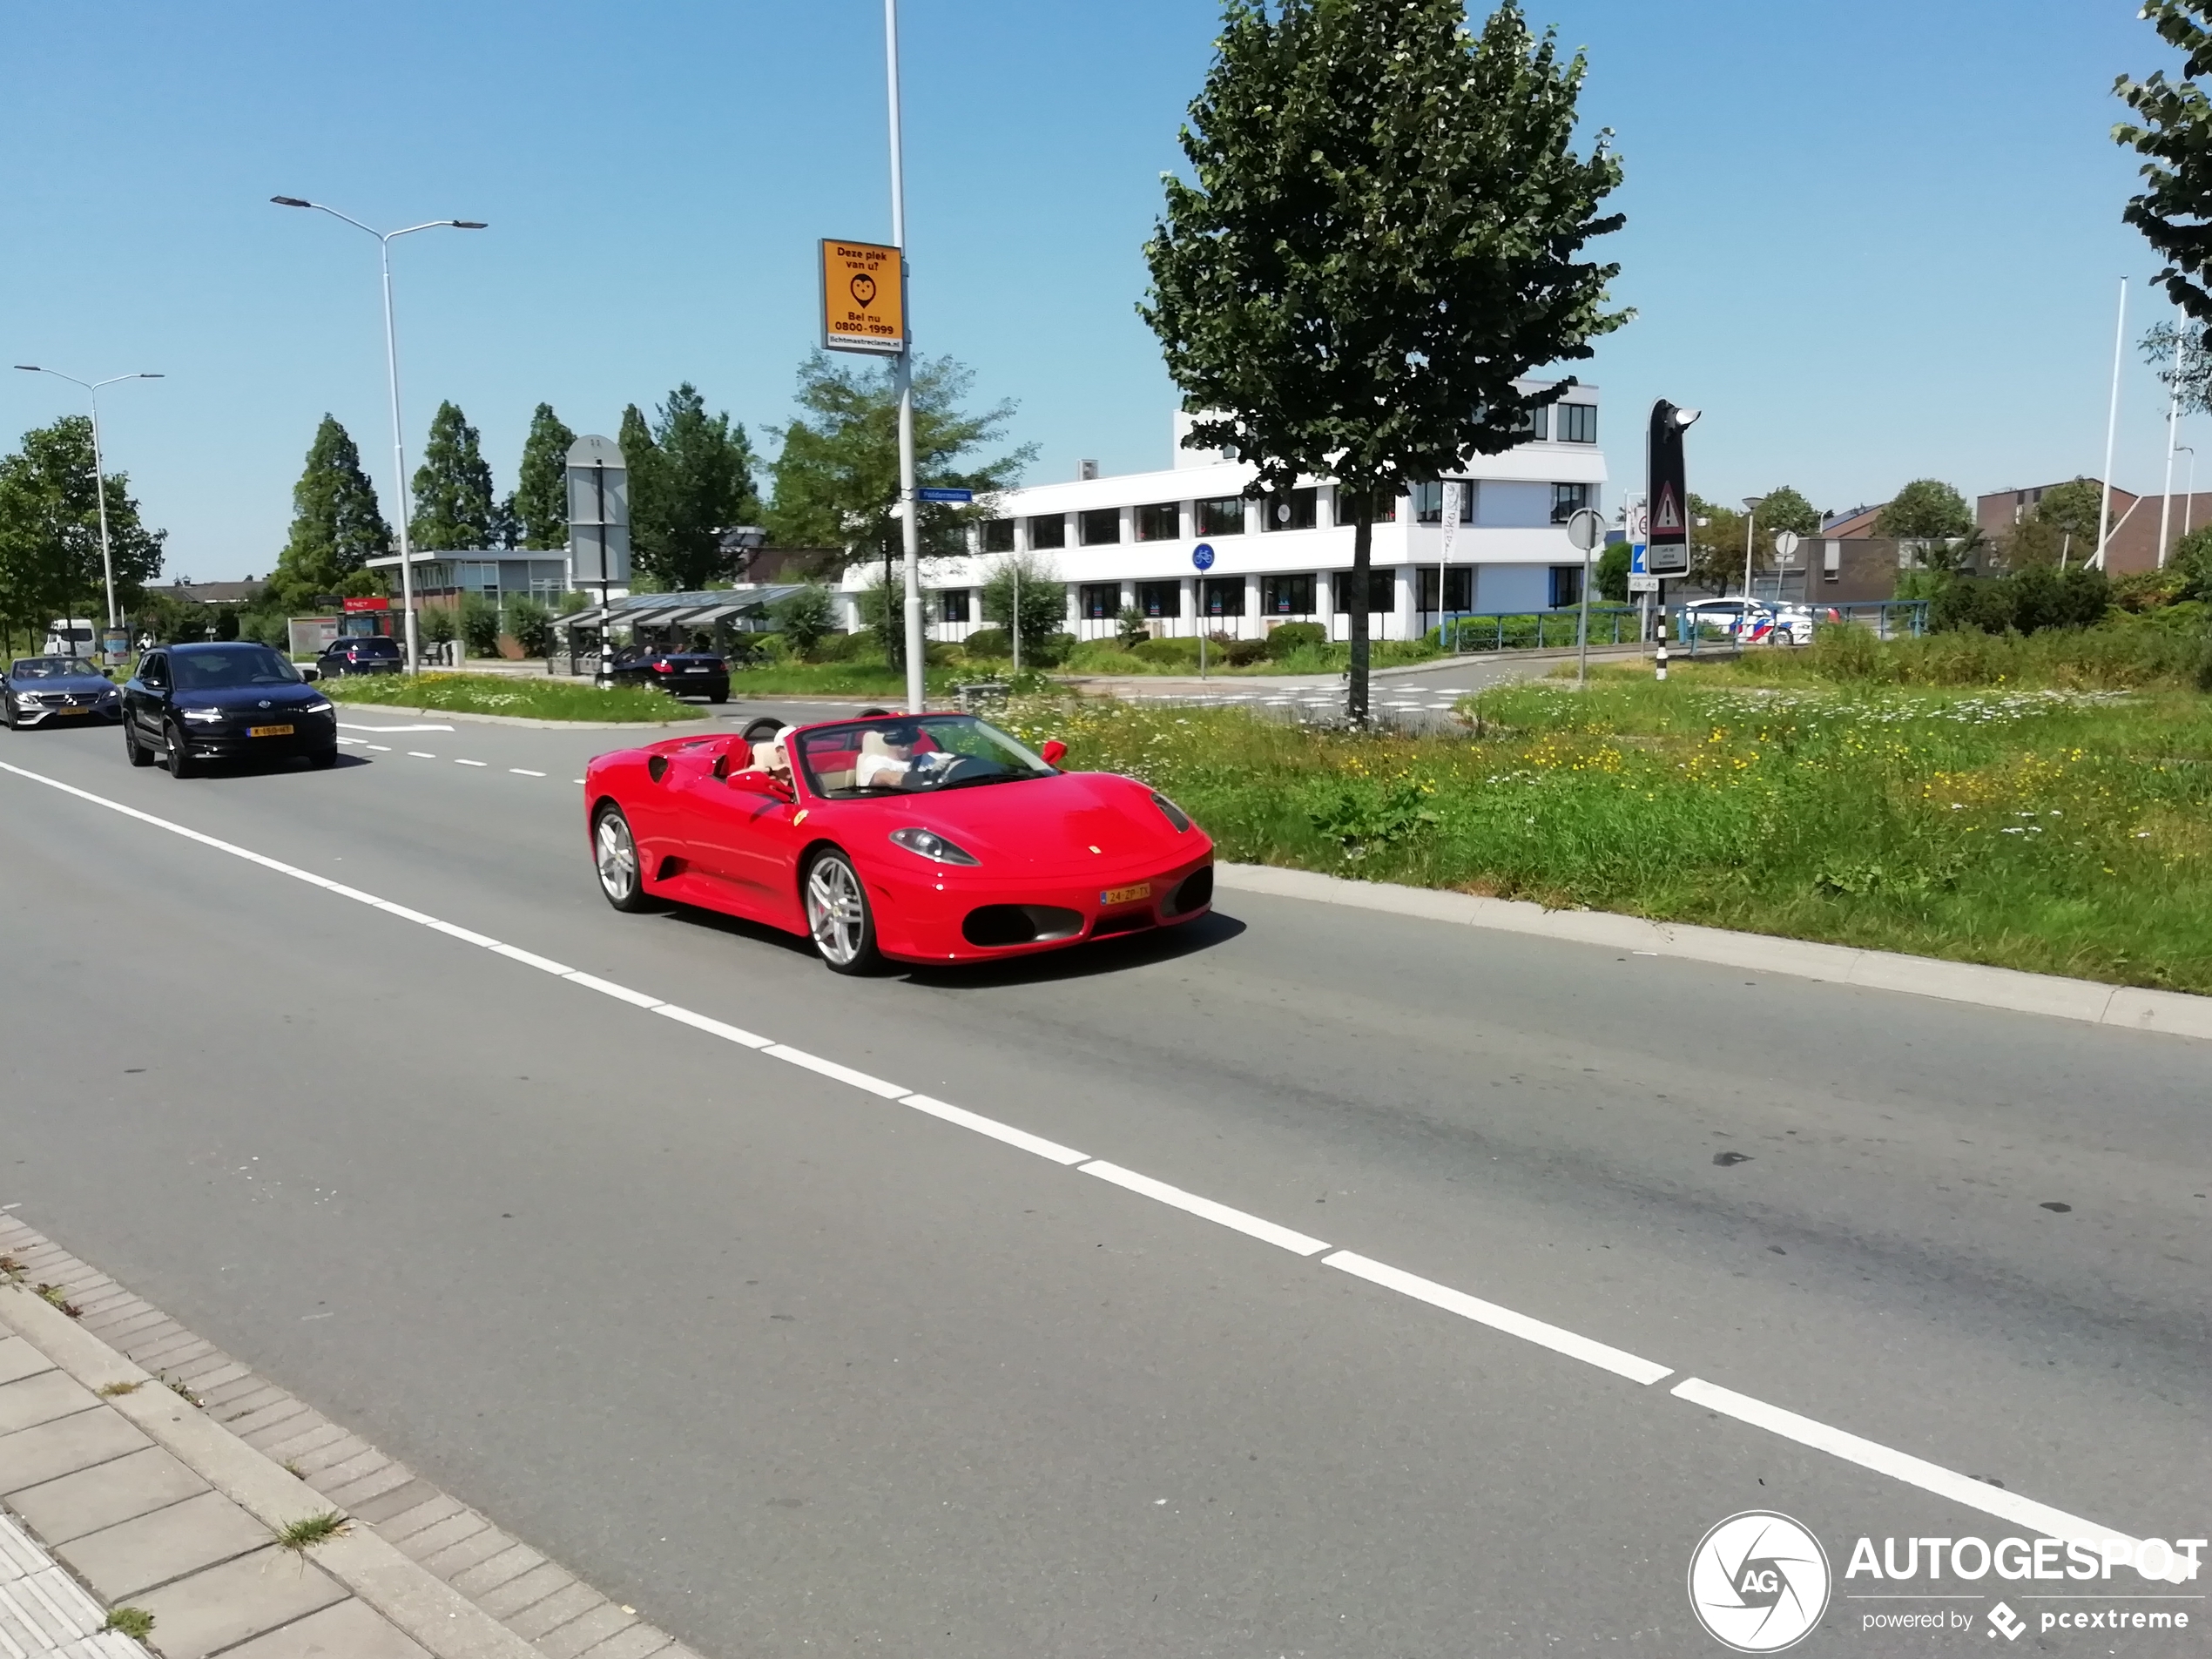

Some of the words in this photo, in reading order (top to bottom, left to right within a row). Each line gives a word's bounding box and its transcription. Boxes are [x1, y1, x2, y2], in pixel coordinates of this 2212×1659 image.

[837, 247, 863, 258] Deze
[866, 251, 887, 261] plek
[867, 262, 879, 271] u?
[847, 312, 865, 321] Bel
[867, 314, 880, 323] nu
[829, 336, 900, 347] lichtmastreclame.nl
